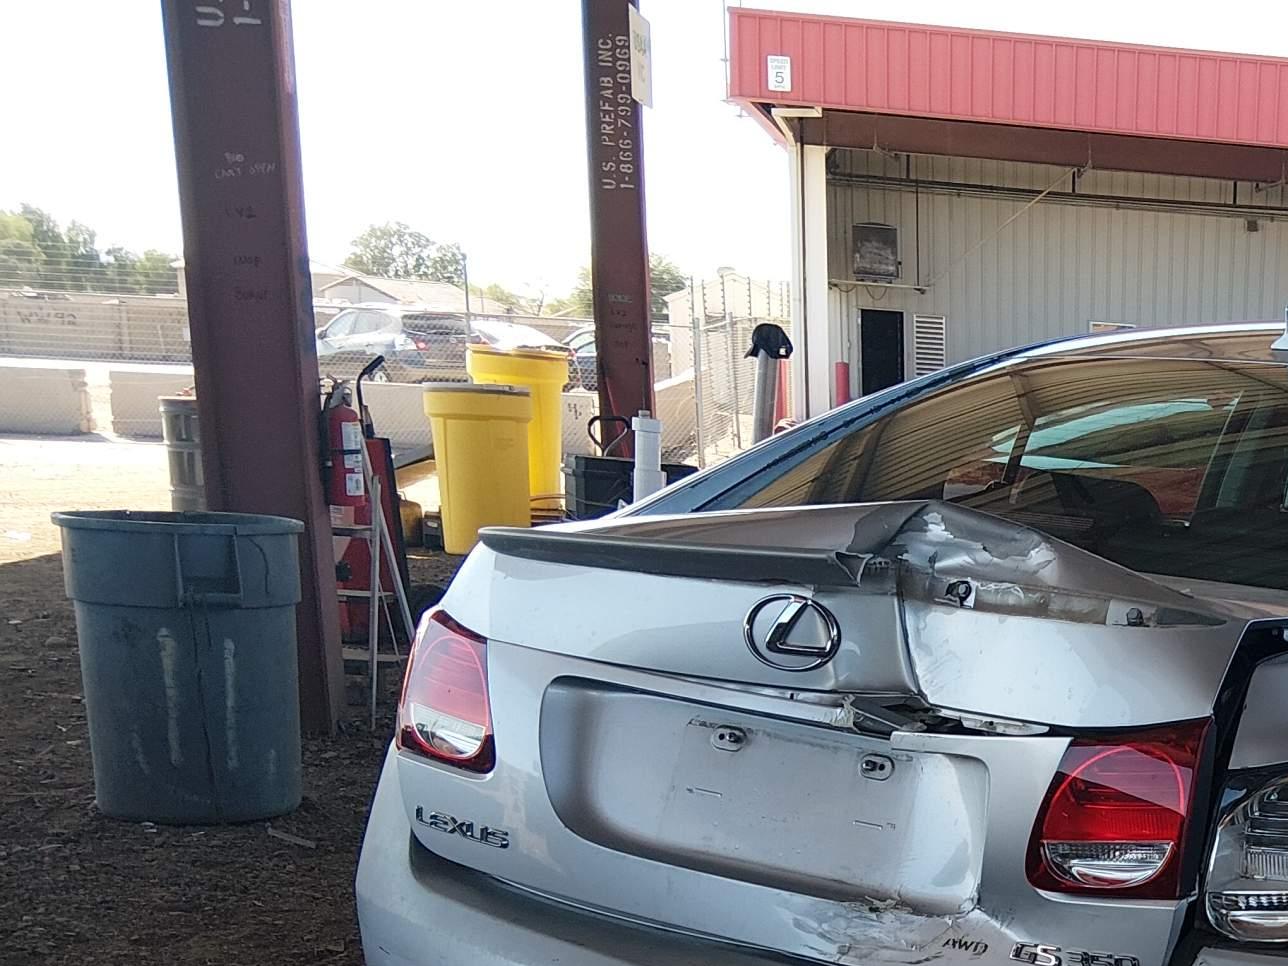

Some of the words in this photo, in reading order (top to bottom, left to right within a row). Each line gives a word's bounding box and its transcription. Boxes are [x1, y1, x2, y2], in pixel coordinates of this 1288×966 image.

[598, 33, 614, 67] INC.
[775, 71, 785, 84] 5
[600, 76, 616, 146] PREFAB
[615, 35, 635, 190] 1-866-799-0969
[601, 156, 617, 190] U.S.
[415, 805, 510, 849] LEXUS
[942, 937, 989, 955] AWD
